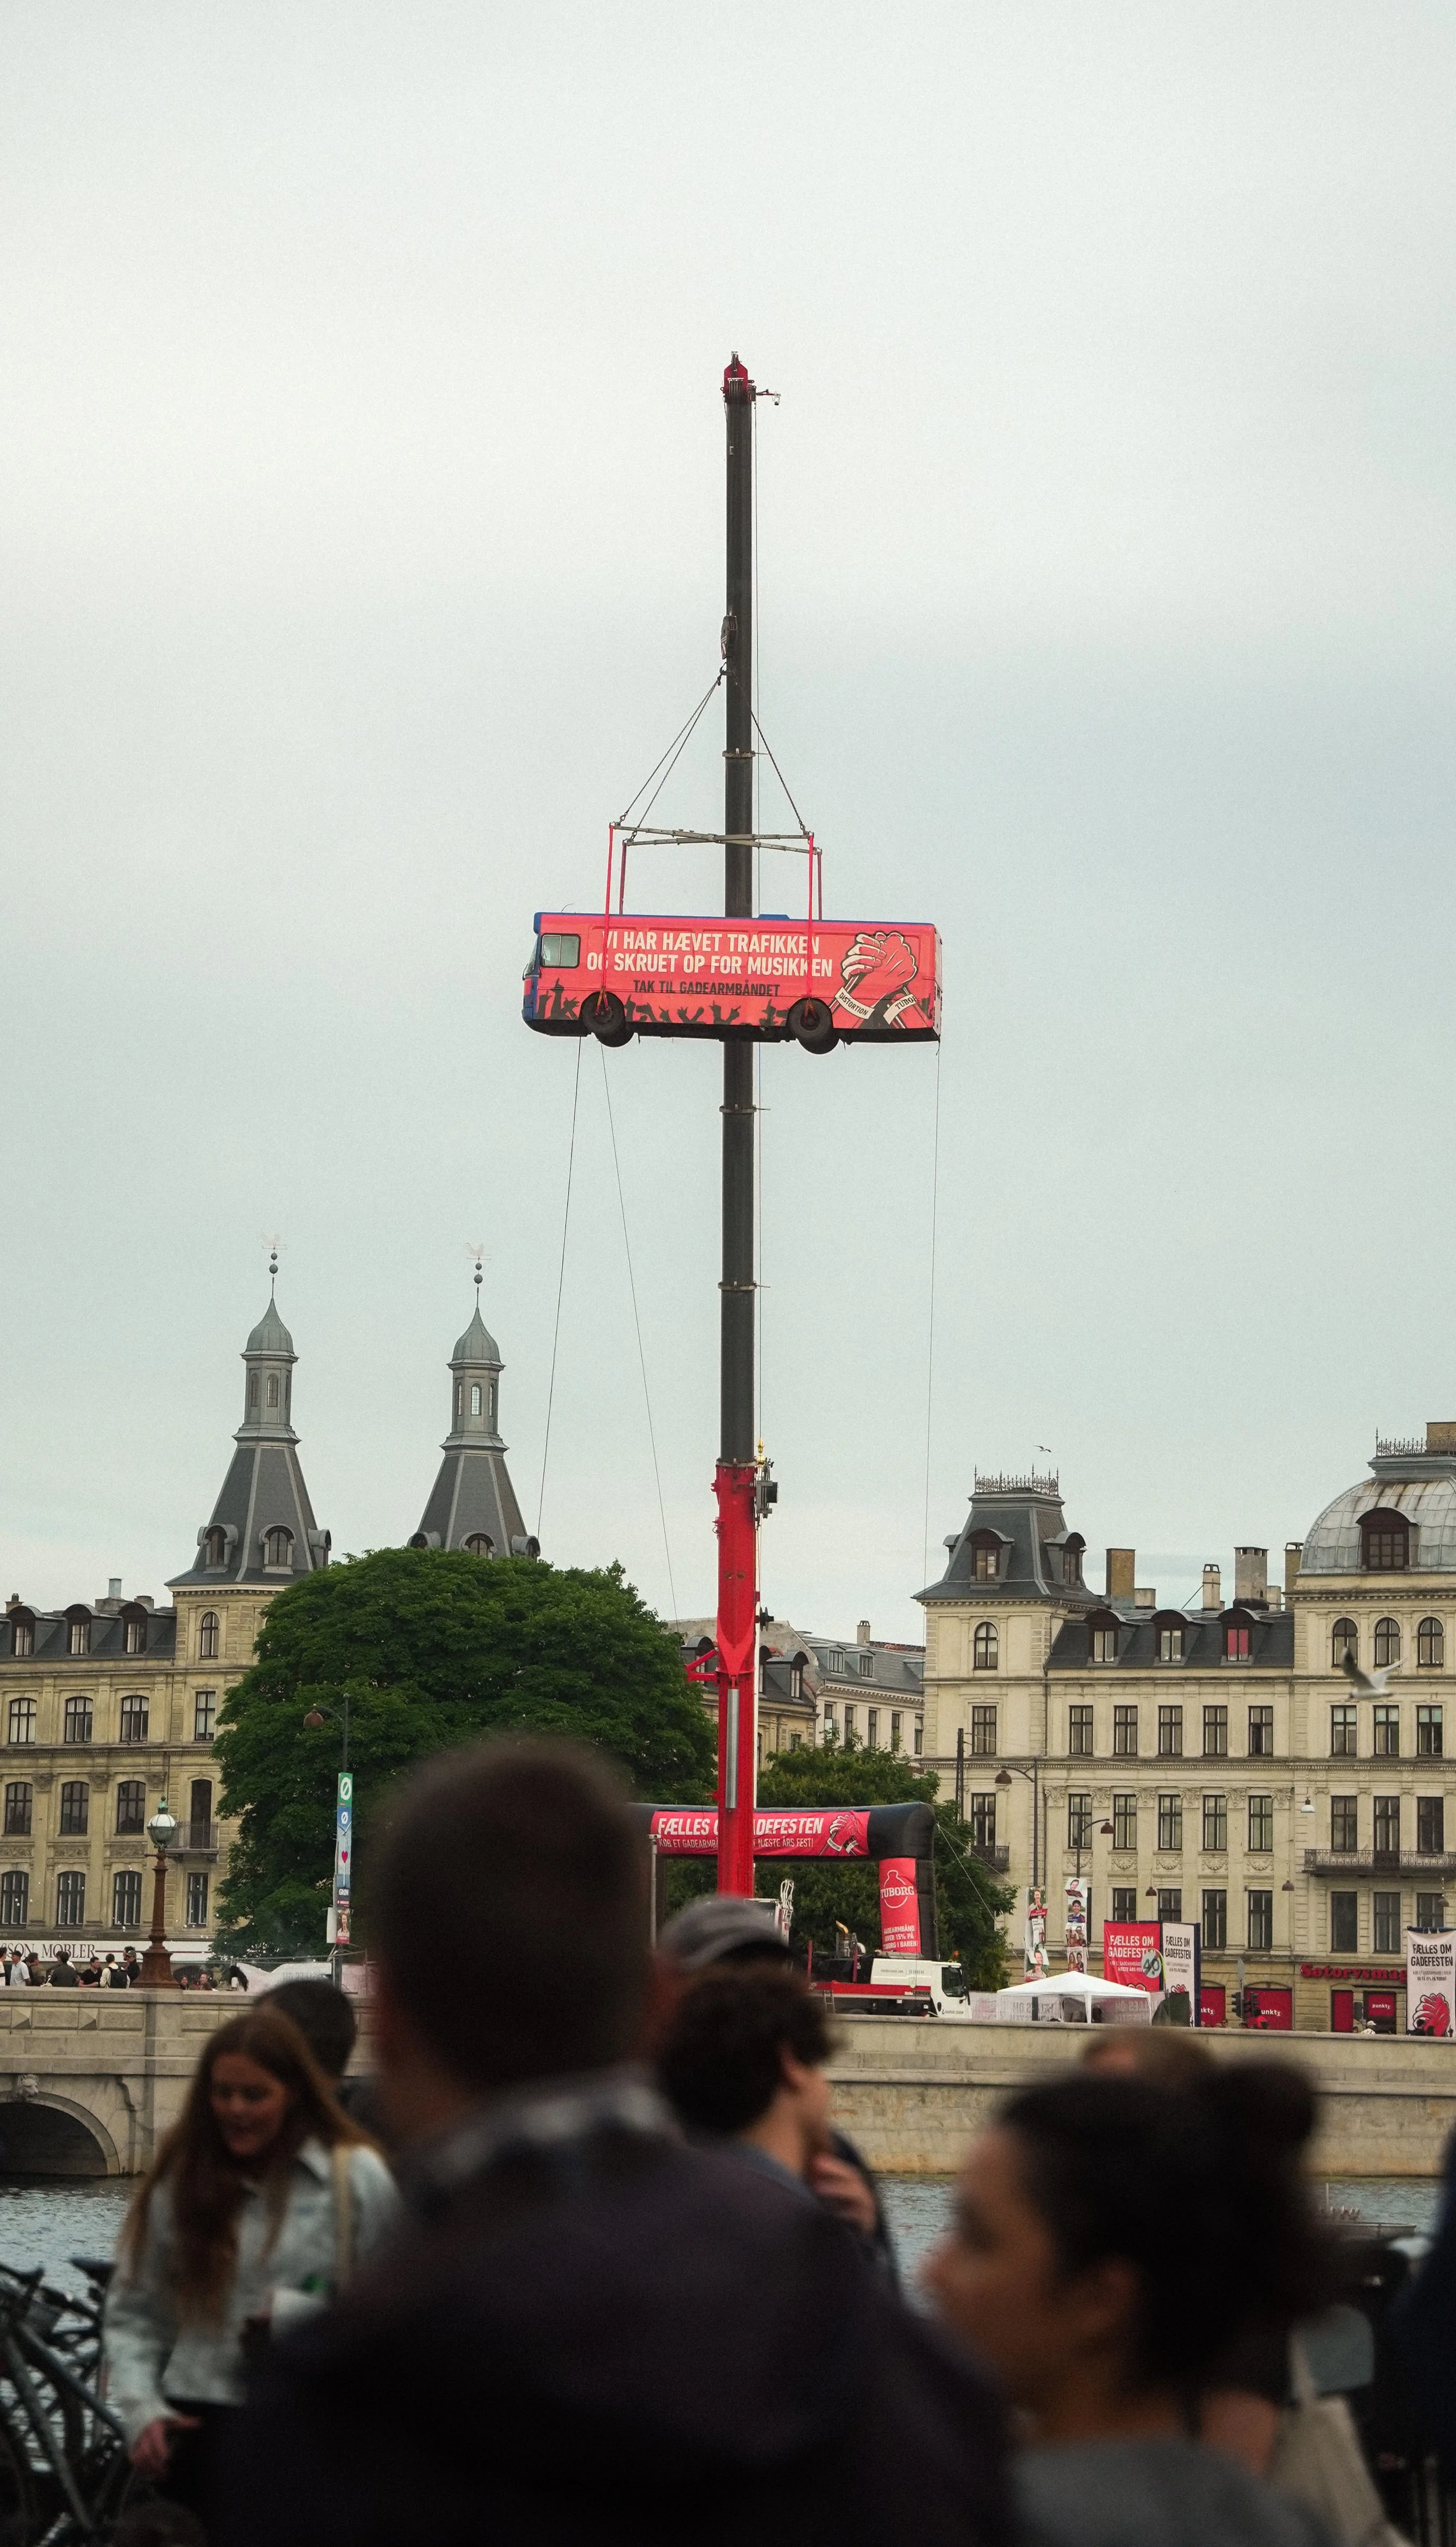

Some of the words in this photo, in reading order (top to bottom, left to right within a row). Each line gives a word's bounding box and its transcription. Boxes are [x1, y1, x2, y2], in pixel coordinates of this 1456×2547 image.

[602, 930, 617, 949] VI
[623, 931, 657, 951] HAR
[662, 932, 722, 952] HÆVET
[727, 934, 819, 955] TRAFIKKEN
[586, 952, 609, 971] OG
[613, 953, 678, 973] SKRUET
[683, 955, 705, 973] OP
[710, 955, 742, 974] FOR
[747, 956, 833, 977] MUSIKKEN
[634, 980, 654, 992] TAK
[659, 981, 676, 994] TIL
[680, 979, 780, 997] GADEARMBÅNDET
[839, 992, 869, 1016] DISTORTION
[658, 1818, 711, 1836] FÆLLES
[753, 1818, 824, 1836] DEFESTEN
[673, 1839, 680, 1848] ET
[758, 1838, 780, 1847] NÆSTE
[782, 1836, 795, 1847] ÅRS
[881, 1886, 914, 1898] TUBORG
[1110, 1935, 1140, 1946] FÆLLES
[1142, 1936, 1154, 1946] OM
[1166, 1935, 1183, 1947] FÆLLES
[1183, 1938, 1190, 1948] OM
[1108, 1947, 1155, 1958] GADEFEST
[1165, 1948, 1191, 1959] GADEFESTEN
[1412, 1944, 1438, 1954] FÆLLES
[1440, 1944, 1452, 1954] OM
[1411, 1956, 1453, 1966] GADEFESTEN
